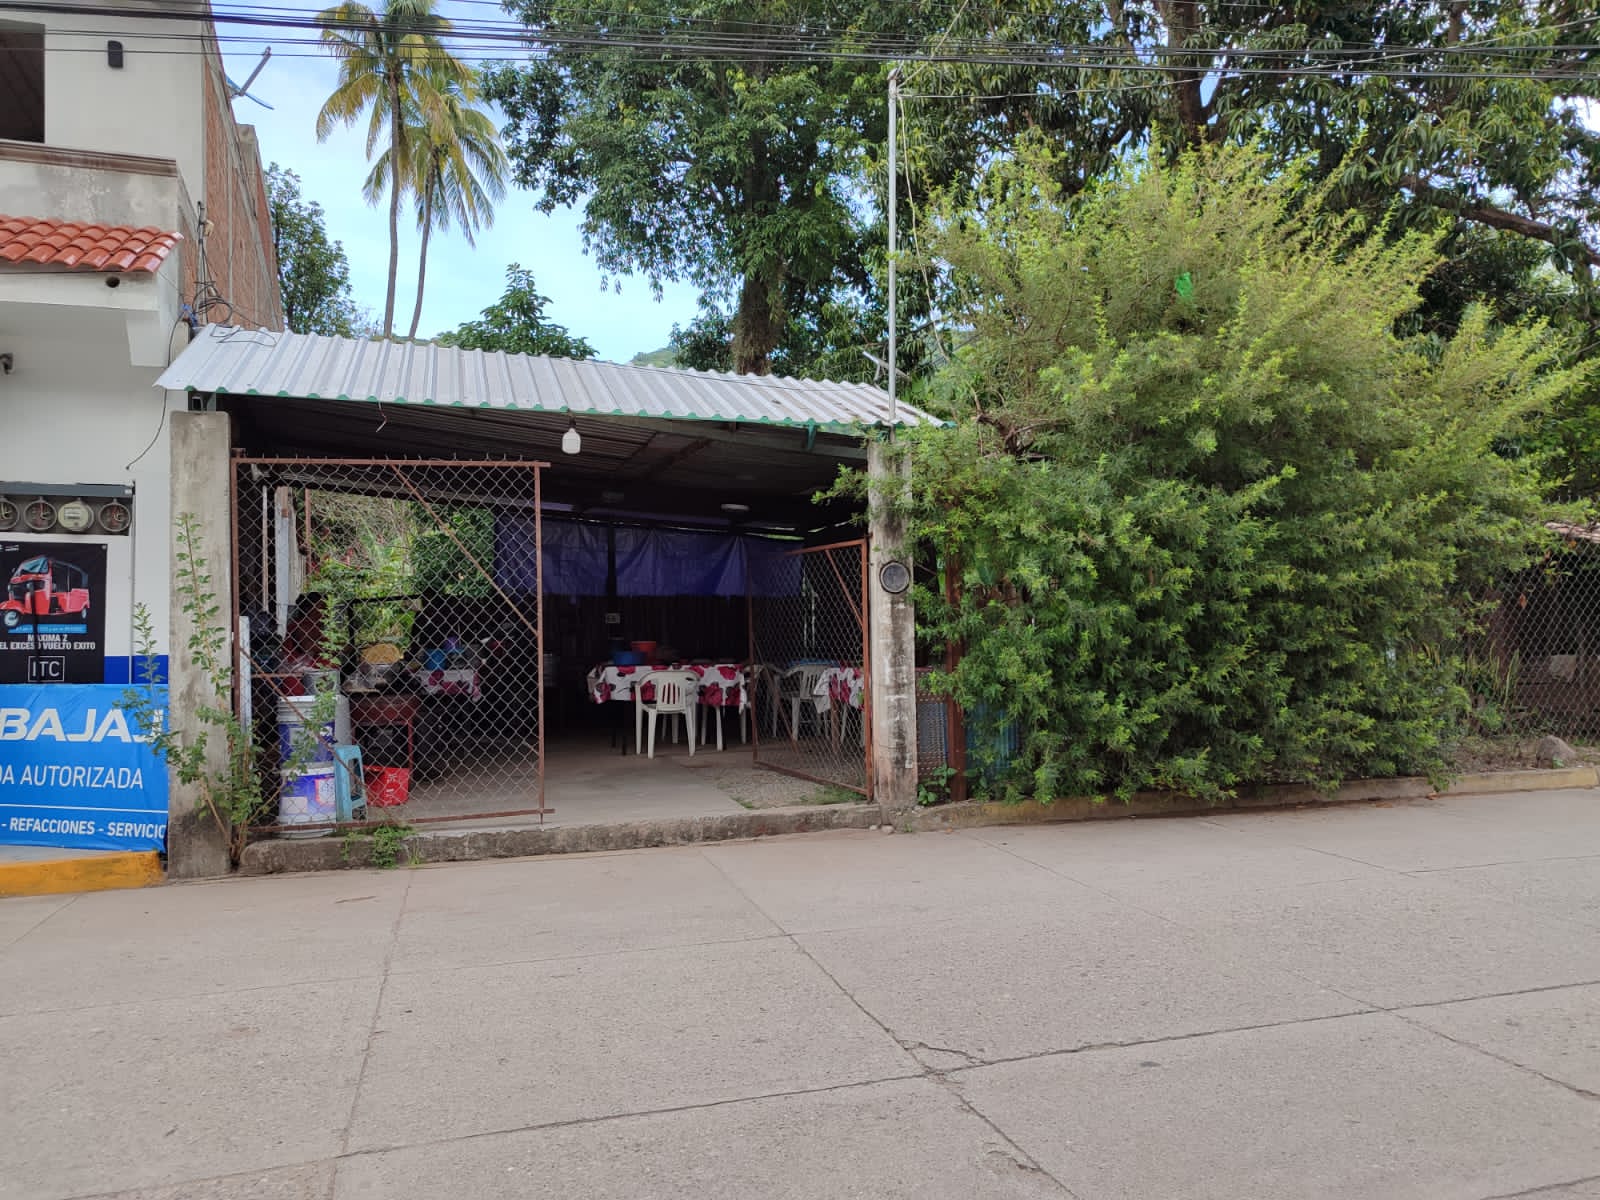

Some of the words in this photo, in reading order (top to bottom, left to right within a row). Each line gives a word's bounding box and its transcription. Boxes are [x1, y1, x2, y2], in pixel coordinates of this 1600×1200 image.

[0, 641, 9, 650] EL
[10, 641, 41, 650] EXCES
[42, 641, 72, 650] VUELTO
[28, 634, 61, 642] MXIMA
[32, 660, 61, 678] ITC
[0, 707, 164, 744] BAJAJ
[20, 764, 144, 790] AUTORIZADA
[9, 816, 96, 835] REFACCIONES
